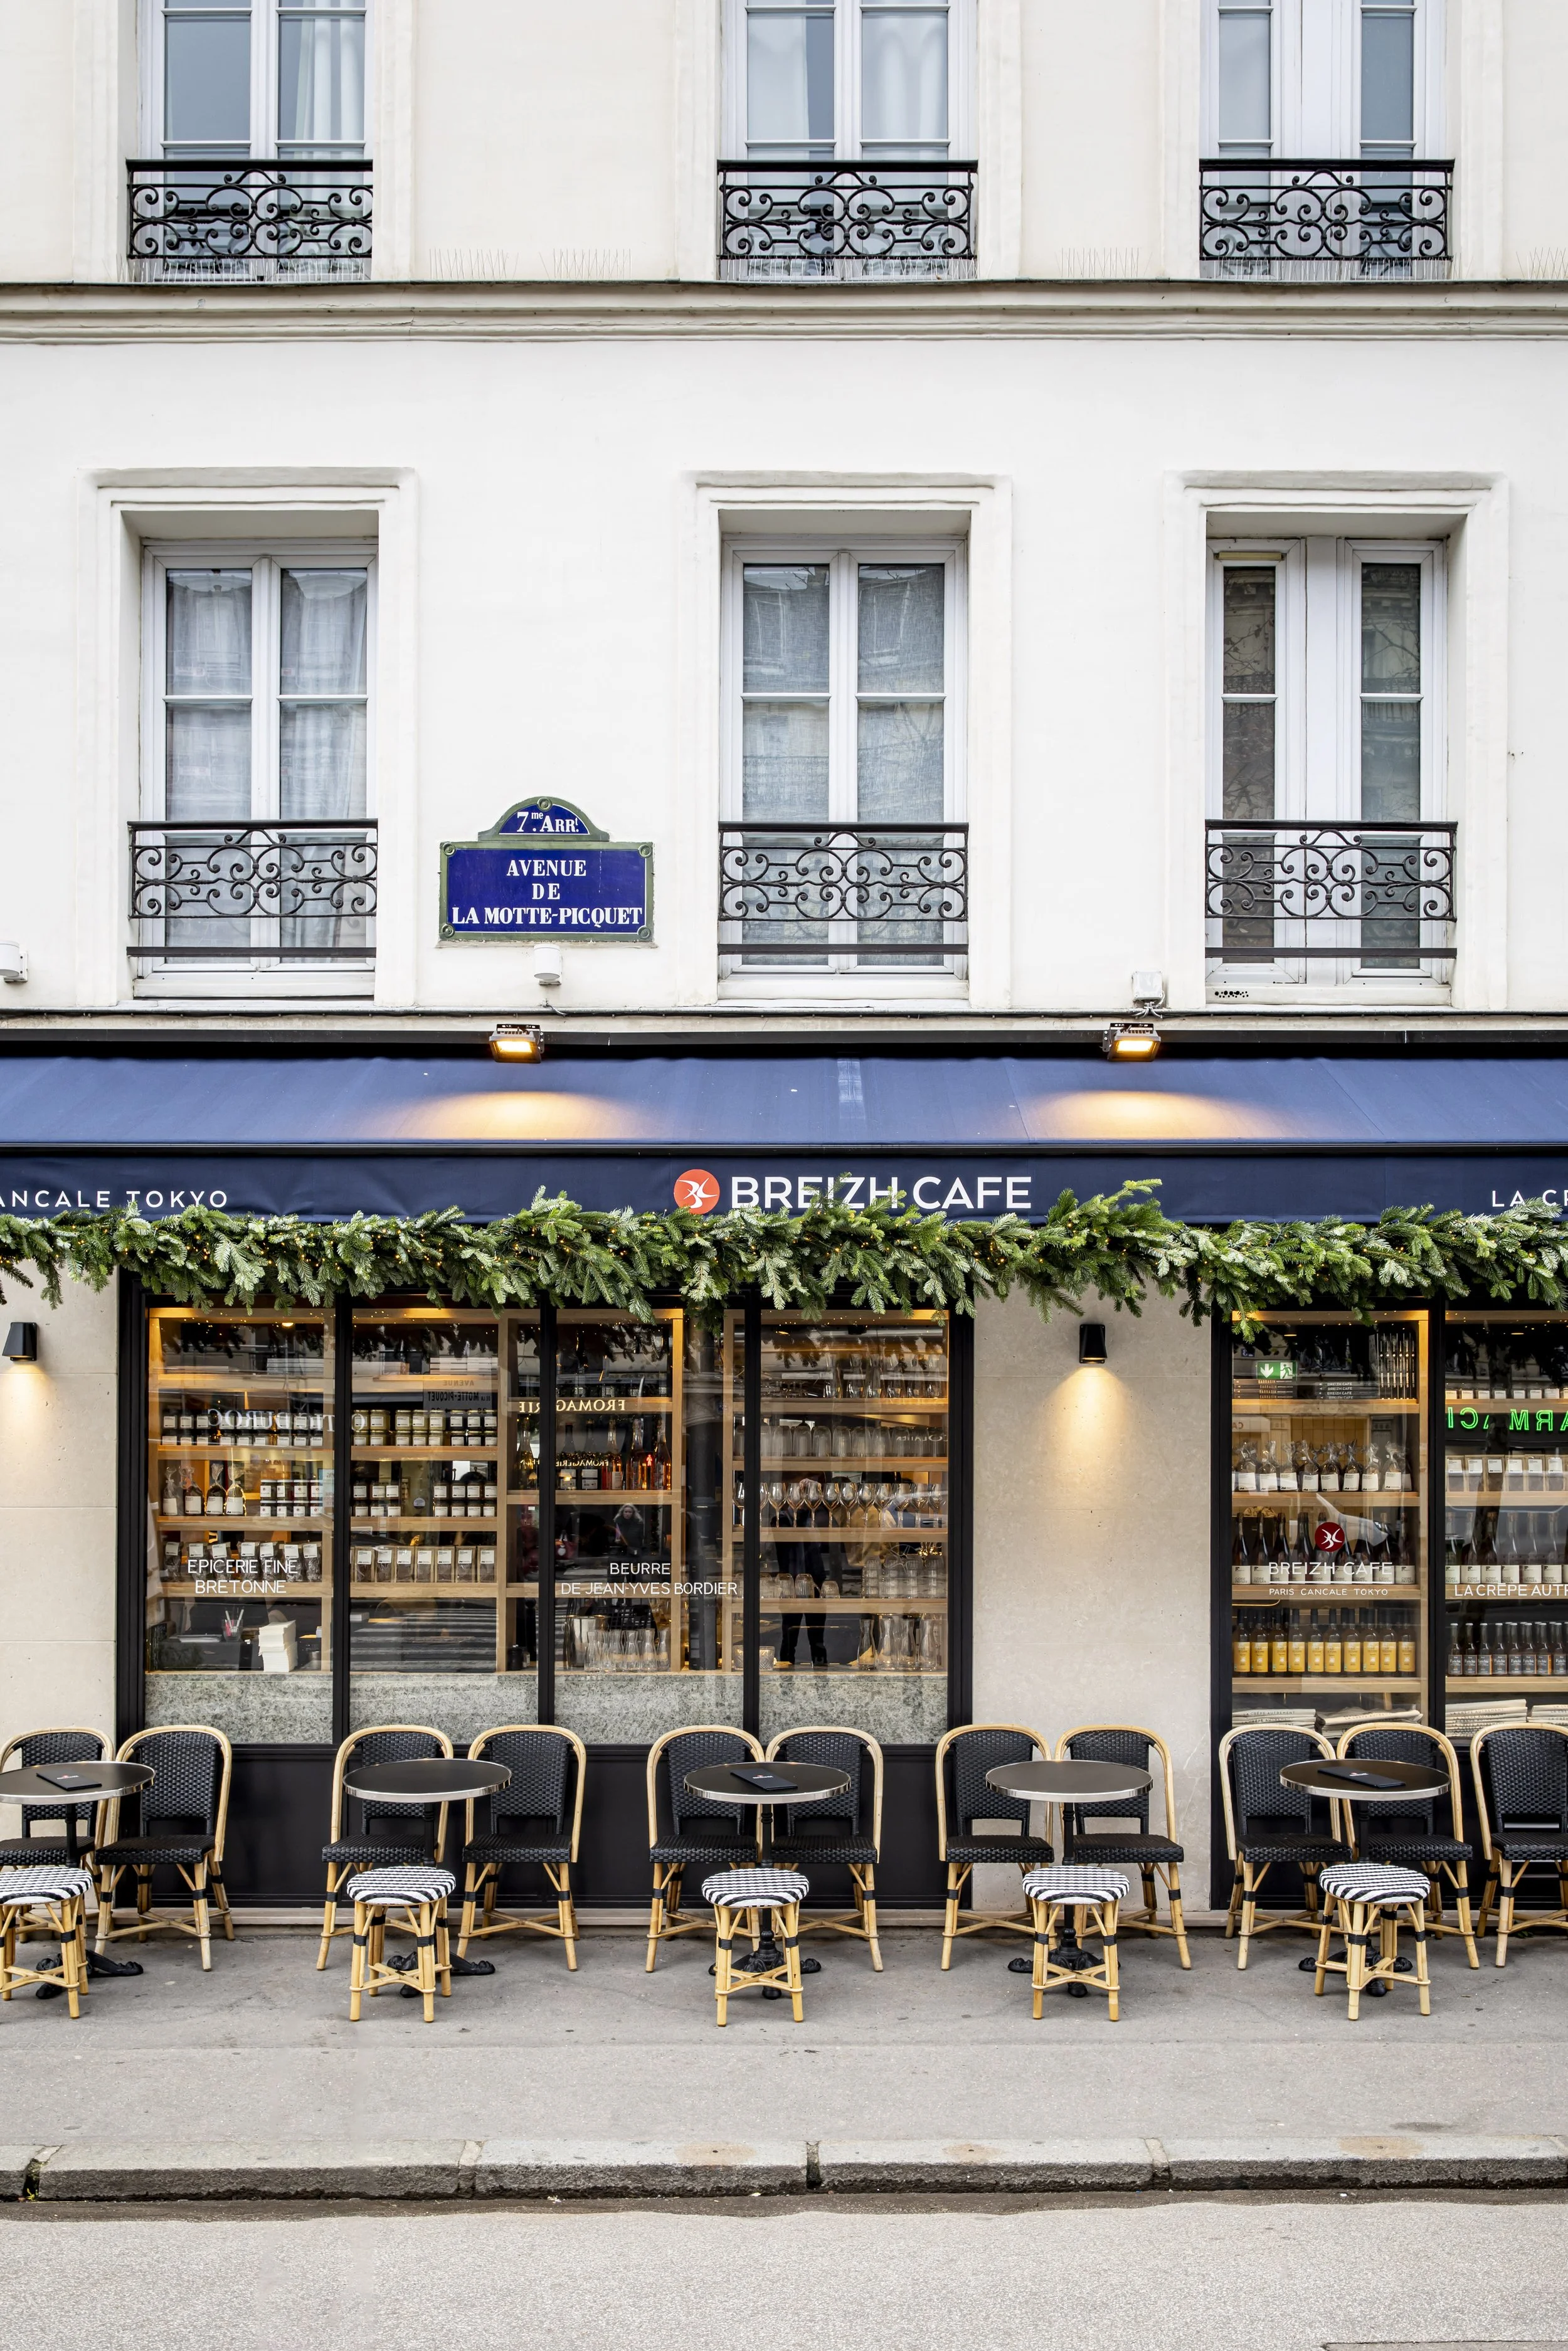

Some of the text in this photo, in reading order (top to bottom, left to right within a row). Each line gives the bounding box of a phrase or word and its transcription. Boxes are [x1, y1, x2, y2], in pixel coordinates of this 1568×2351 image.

[506, 859, 586, 877] AVENUE
[532, 883, 560, 900] DE
[452, 907, 642, 928] LA MOTTE-PICQUET
[126, 1190, 228, 1208] TOKYO
[731, 1176, 1032, 1209] BREIZH CAFE
[1492, 1190, 1526, 1207] LA
[188, 1559, 298, 1574] EPICERIE FINE
[610, 1563, 671, 1574] BEURRE
[1269, 1561, 1393, 1575] BREIZH CAFE
[195, 1579, 287, 1594] BRETONNE
[561, 1582, 738, 1595] DE JEAN-YVES BORDIER
[1454, 1584, 1473, 1596] LA
